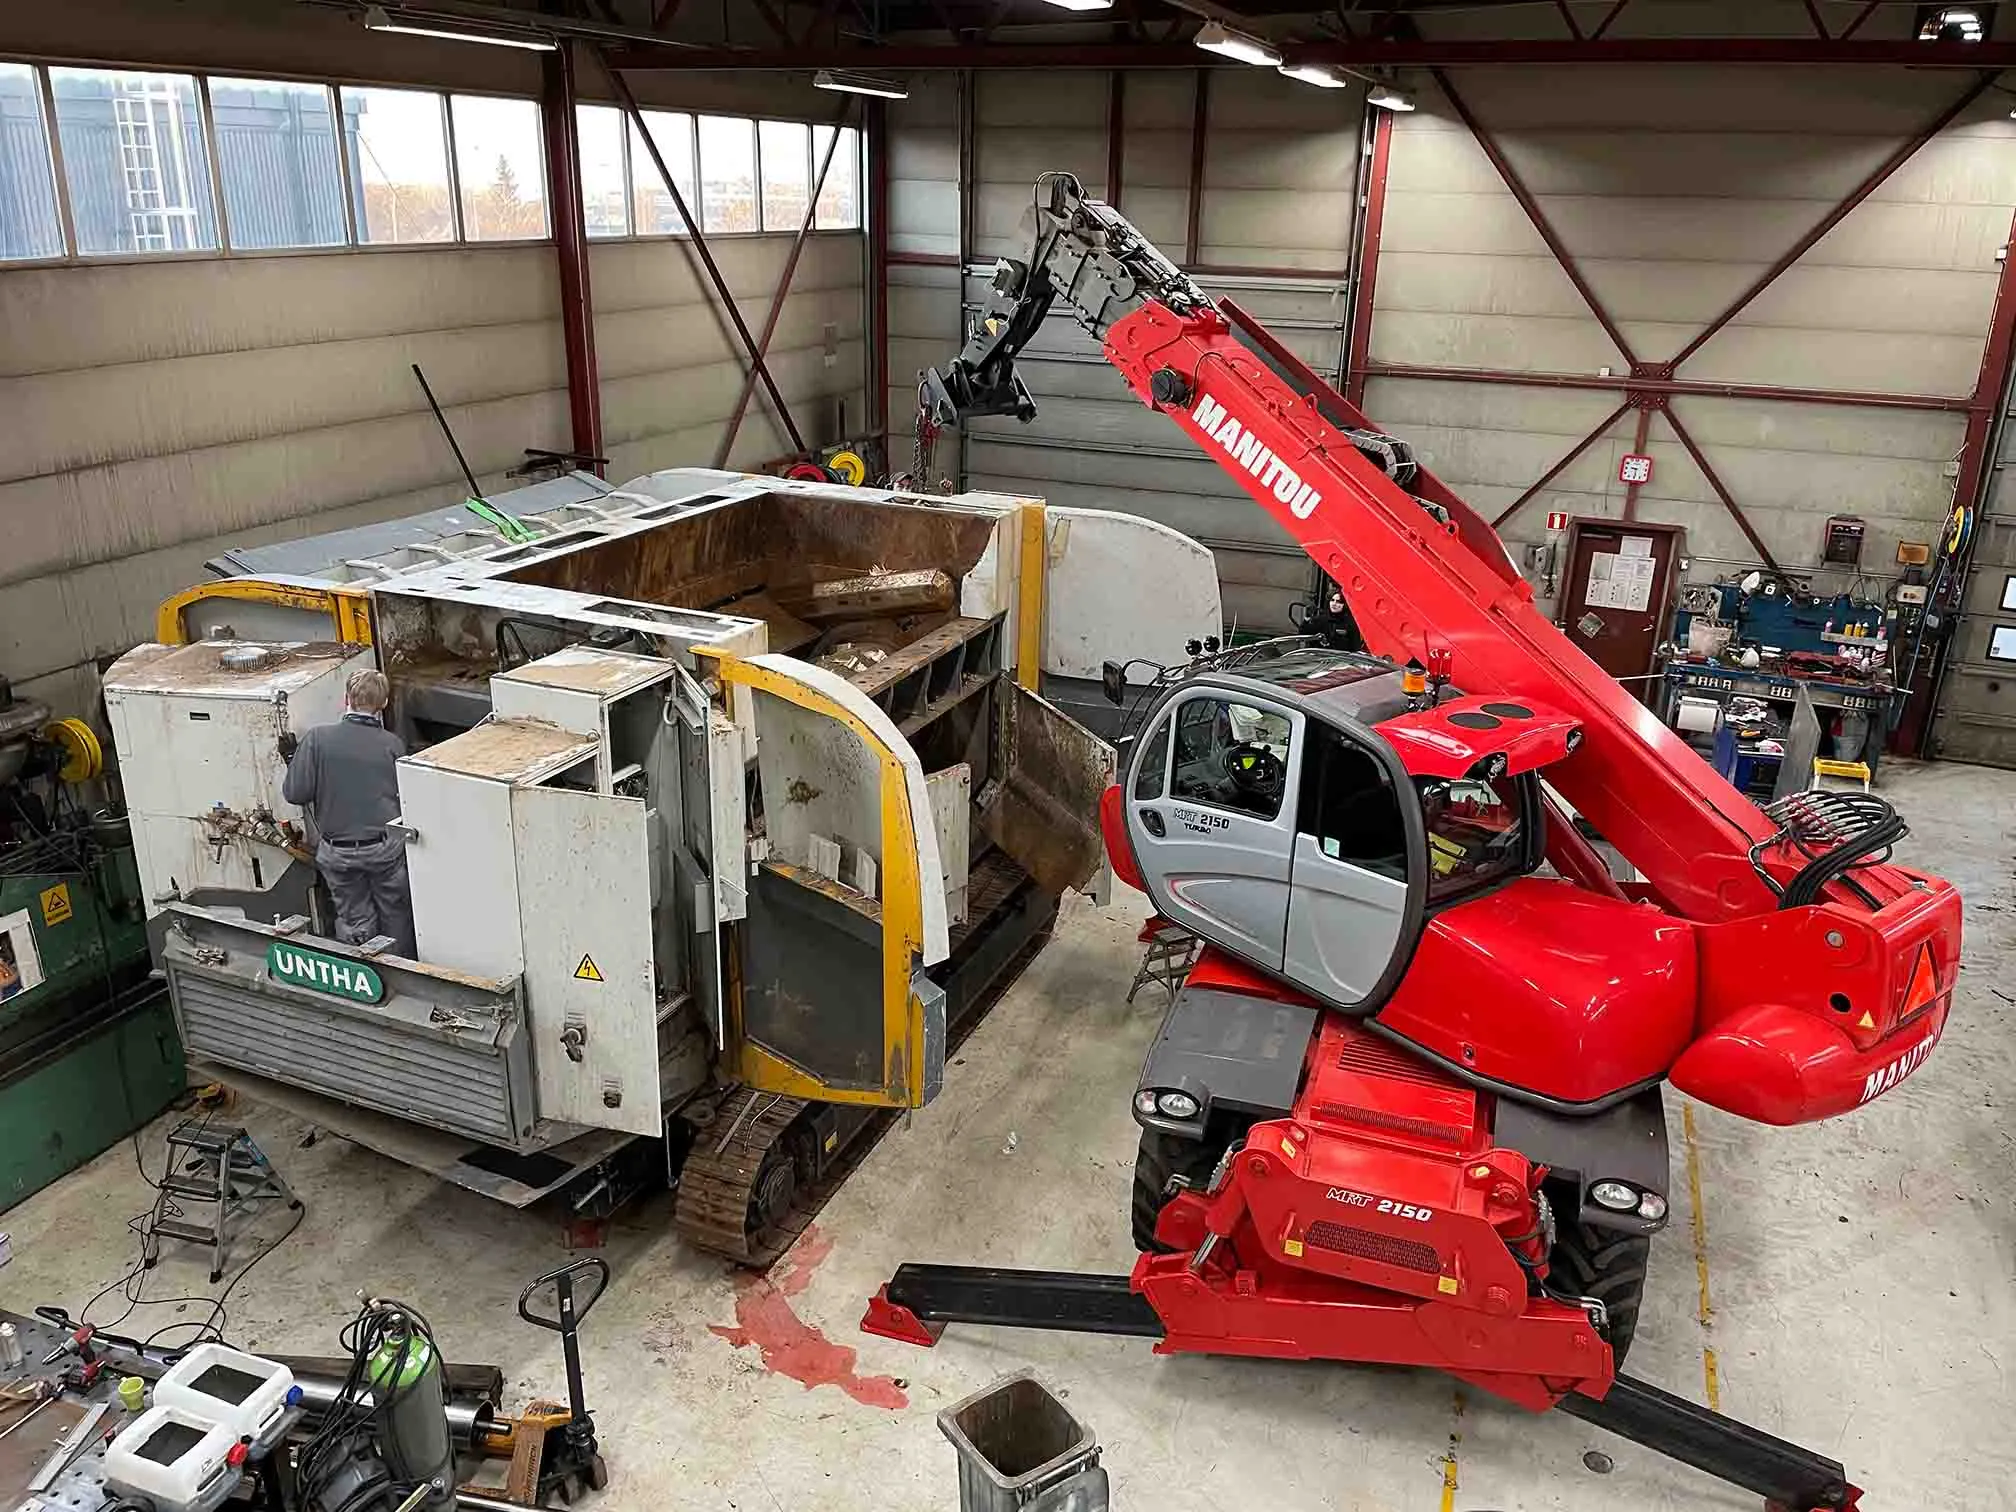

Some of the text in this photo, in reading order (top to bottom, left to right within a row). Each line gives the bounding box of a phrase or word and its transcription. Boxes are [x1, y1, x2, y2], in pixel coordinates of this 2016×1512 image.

[1192, 393, 1322, 520] MANITOU
[1184, 823, 1211, 834] TURBO
[1200, 814, 1230, 829] 2150
[275, 948, 373, 997] UNTHA
[1326, 1187, 1432, 1221] MRT 2150
